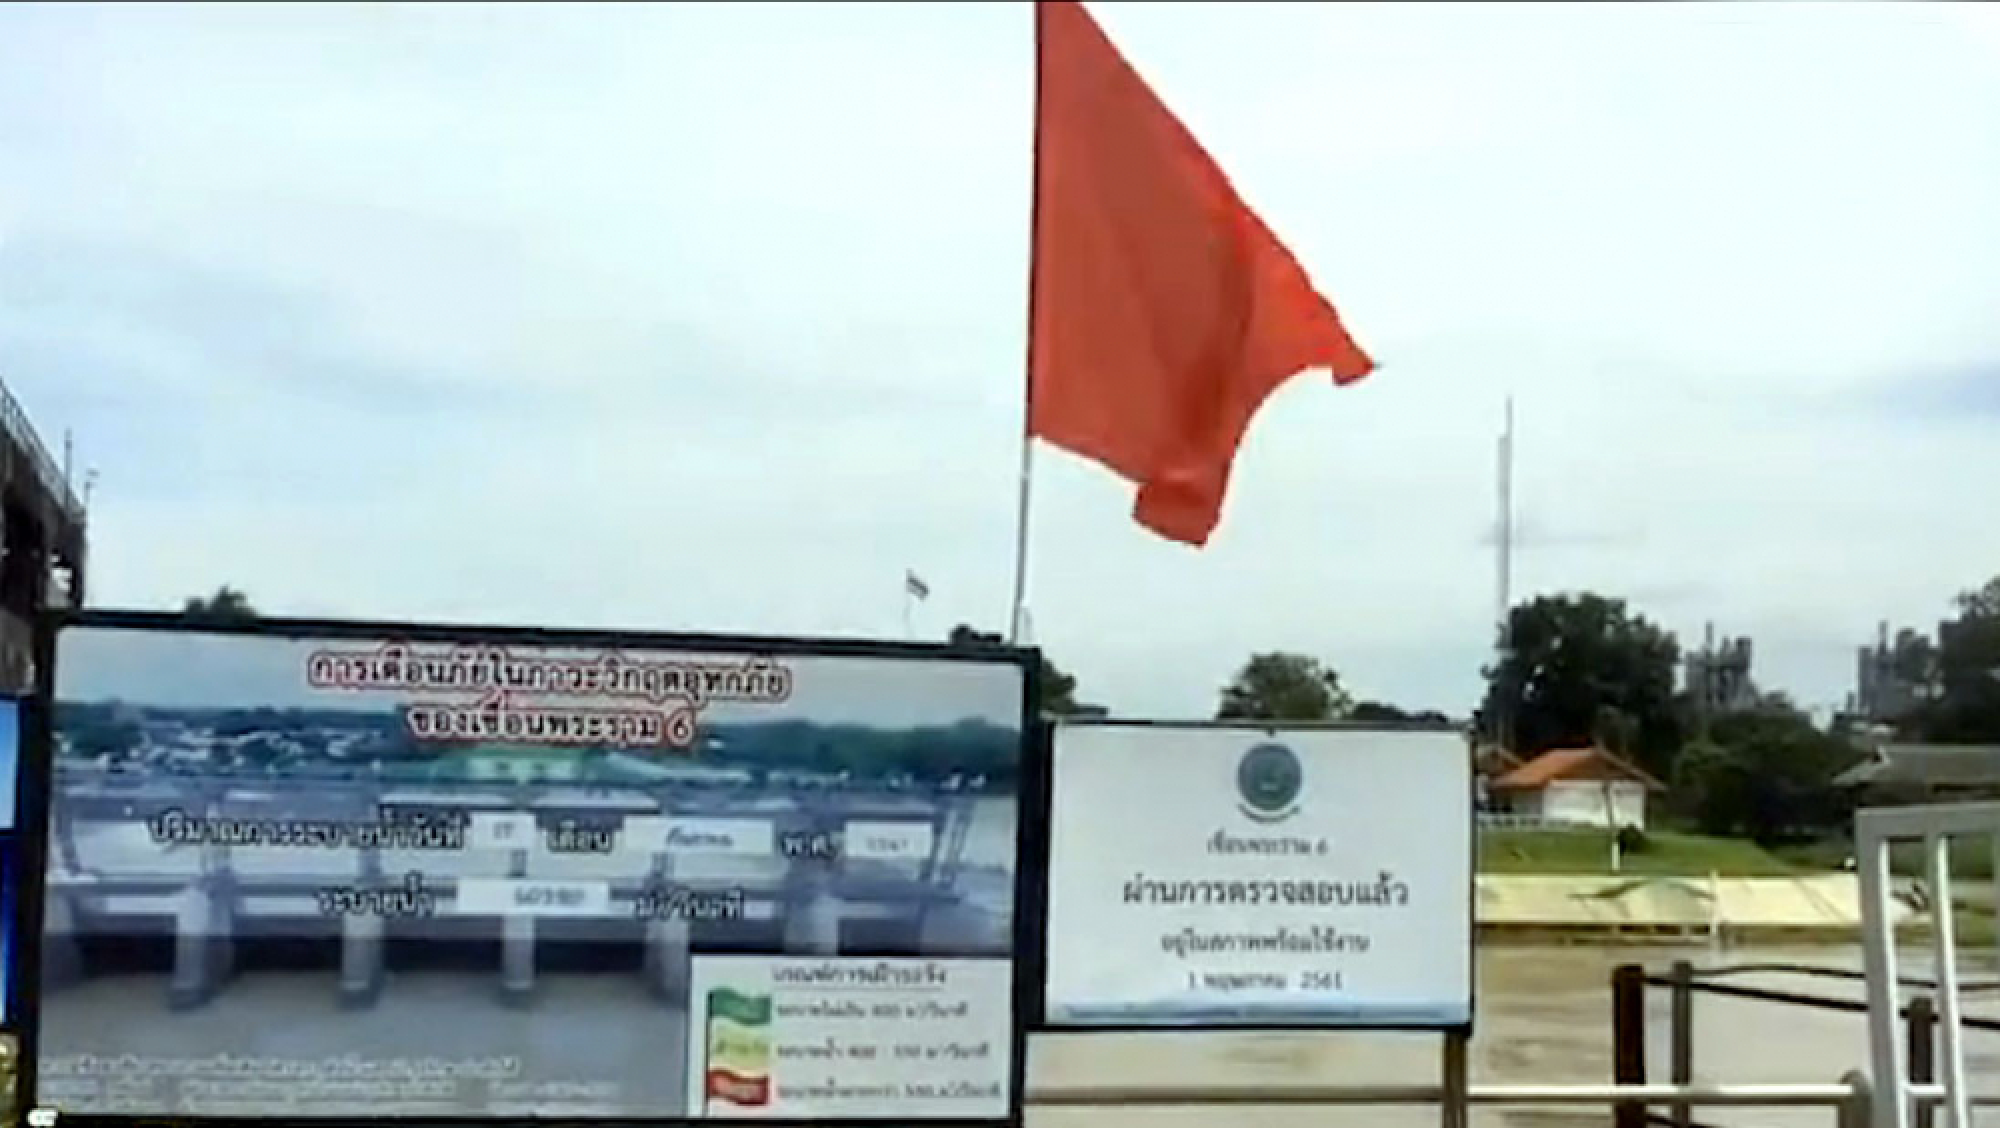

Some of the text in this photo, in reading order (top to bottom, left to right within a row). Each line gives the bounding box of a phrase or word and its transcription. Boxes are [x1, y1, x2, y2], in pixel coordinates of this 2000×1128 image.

[410, 692, 691, 745] ของเขื่อนพระราม 6
[1123, 871, 1410, 906] ผ่านการตรวจสอบแล้ว
[1160, 926, 1371, 958] อยู่ในสภาพพร้อมใช้งาน
